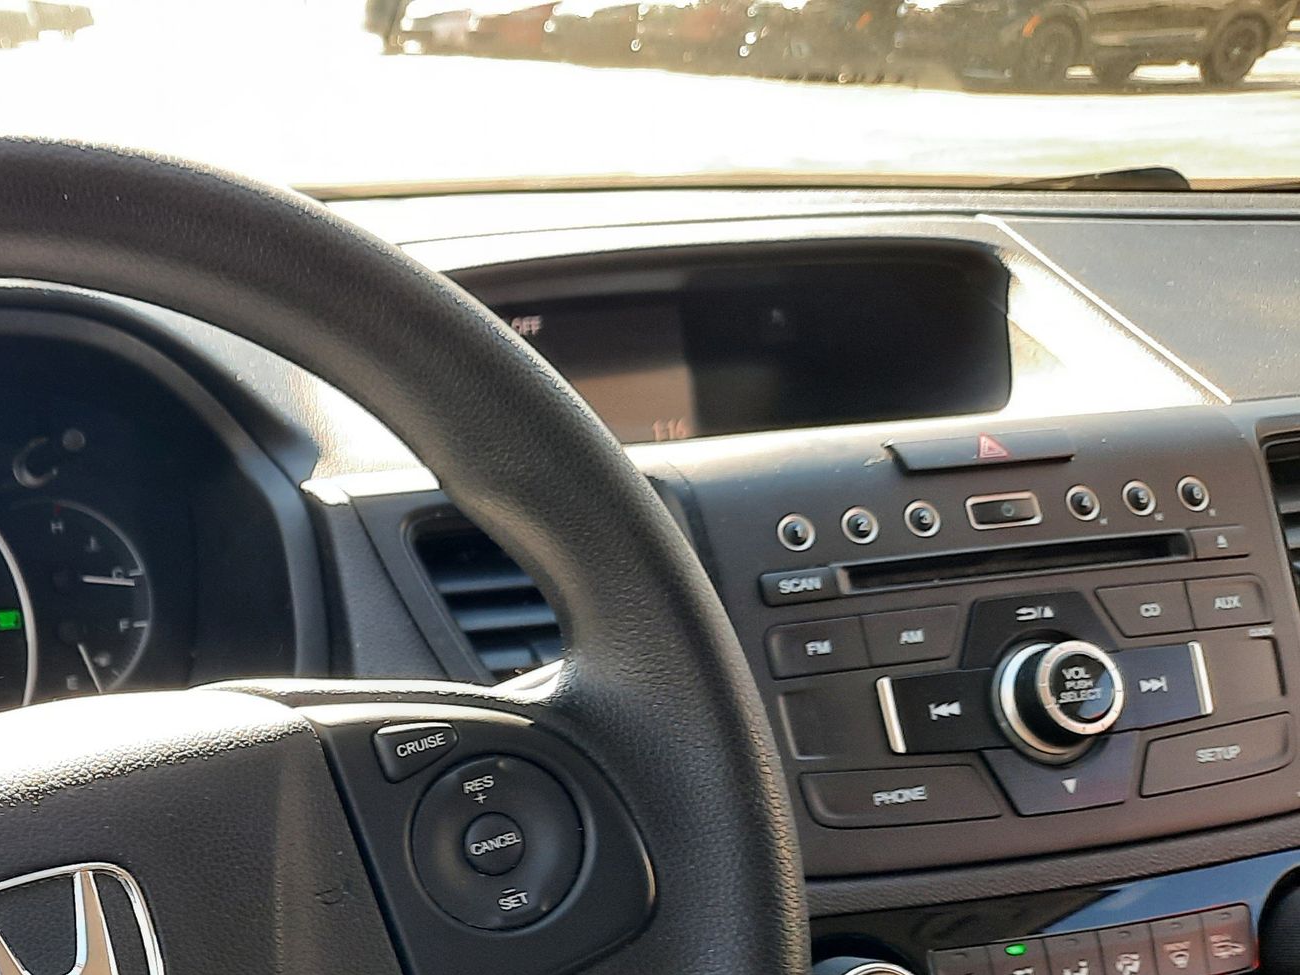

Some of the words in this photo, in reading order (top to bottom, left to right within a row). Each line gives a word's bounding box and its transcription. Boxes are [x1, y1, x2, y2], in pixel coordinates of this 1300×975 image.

[778, 576, 822, 594] SCAN
[1140, 602, 1162, 617] CD
[1214, 595, 1242, 611] AUX
[900, 628, 925, 645] AM
[805, 639, 833, 656] FM
[1061, 666, 1092, 680] VOL
[1064, 680, 1094, 690] PUSH
[396, 733, 447, 757] CRUISE
[1195, 744, 1241, 763] SETUP
[463, 775, 495, 794] RES
[872, 785, 928, 807] PHONE
[469, 832, 521, 856] CANCEL
[498, 891, 529, 911] SET
